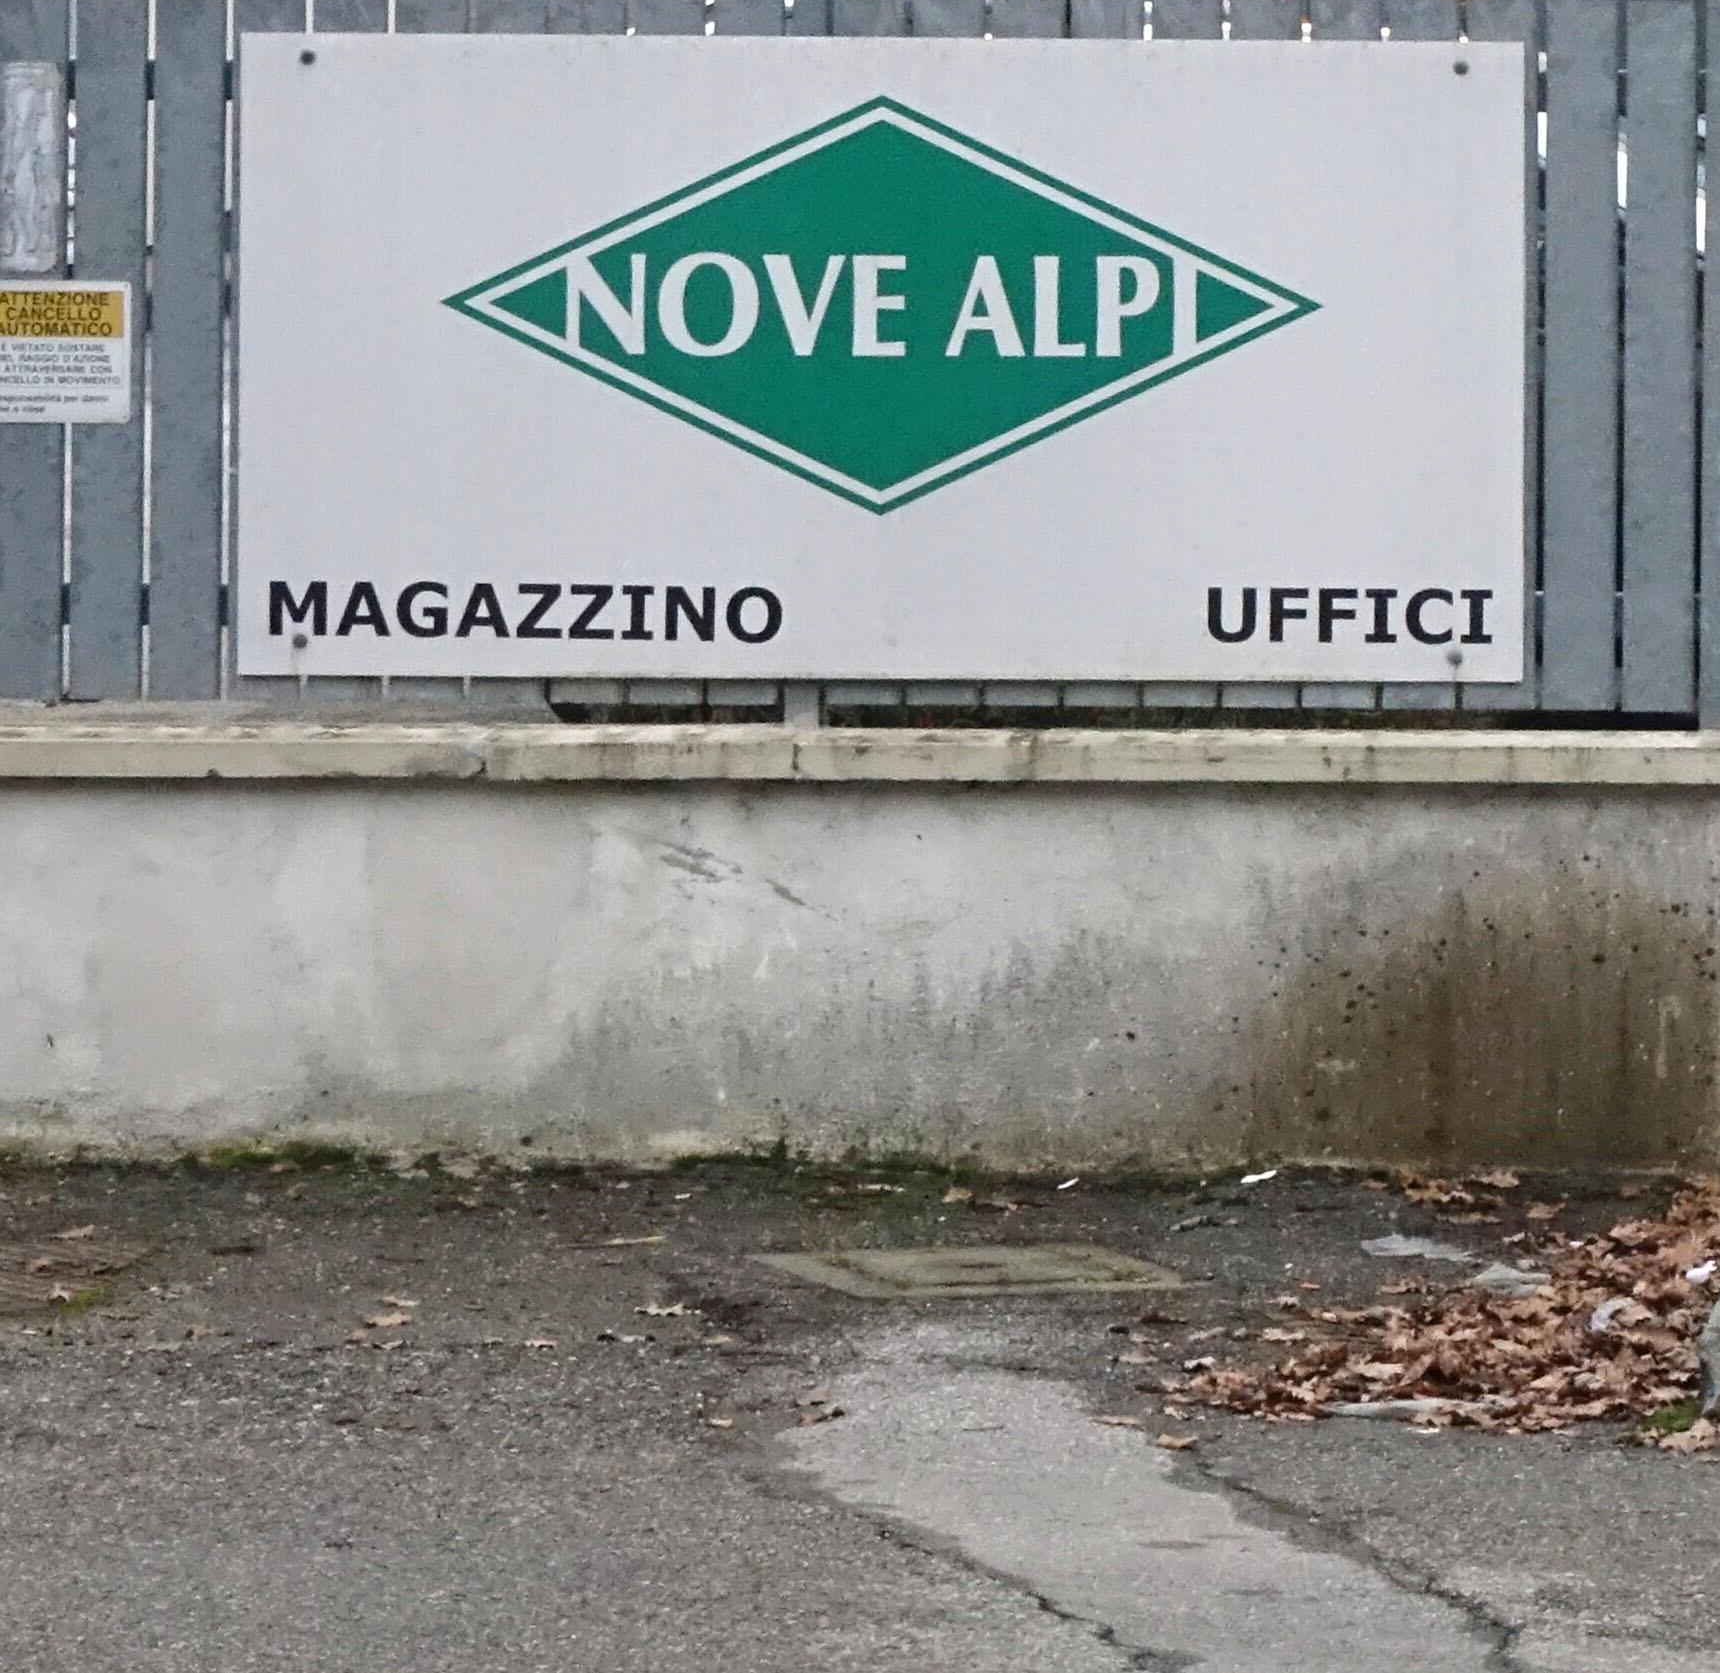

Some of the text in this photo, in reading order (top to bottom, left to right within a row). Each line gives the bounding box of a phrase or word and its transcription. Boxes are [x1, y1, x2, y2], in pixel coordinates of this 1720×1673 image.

[0, 292, 110, 306] ATTENZIONE
[6, 307, 101, 321] CANCELLO
[566, 250, 1198, 358] NOVE ALPI
[0, 323, 113, 336] AUTOMATICO
[268, 580, 784, 645] MAGAZZINO
[1206, 587, 1494, 646] UFFICI
